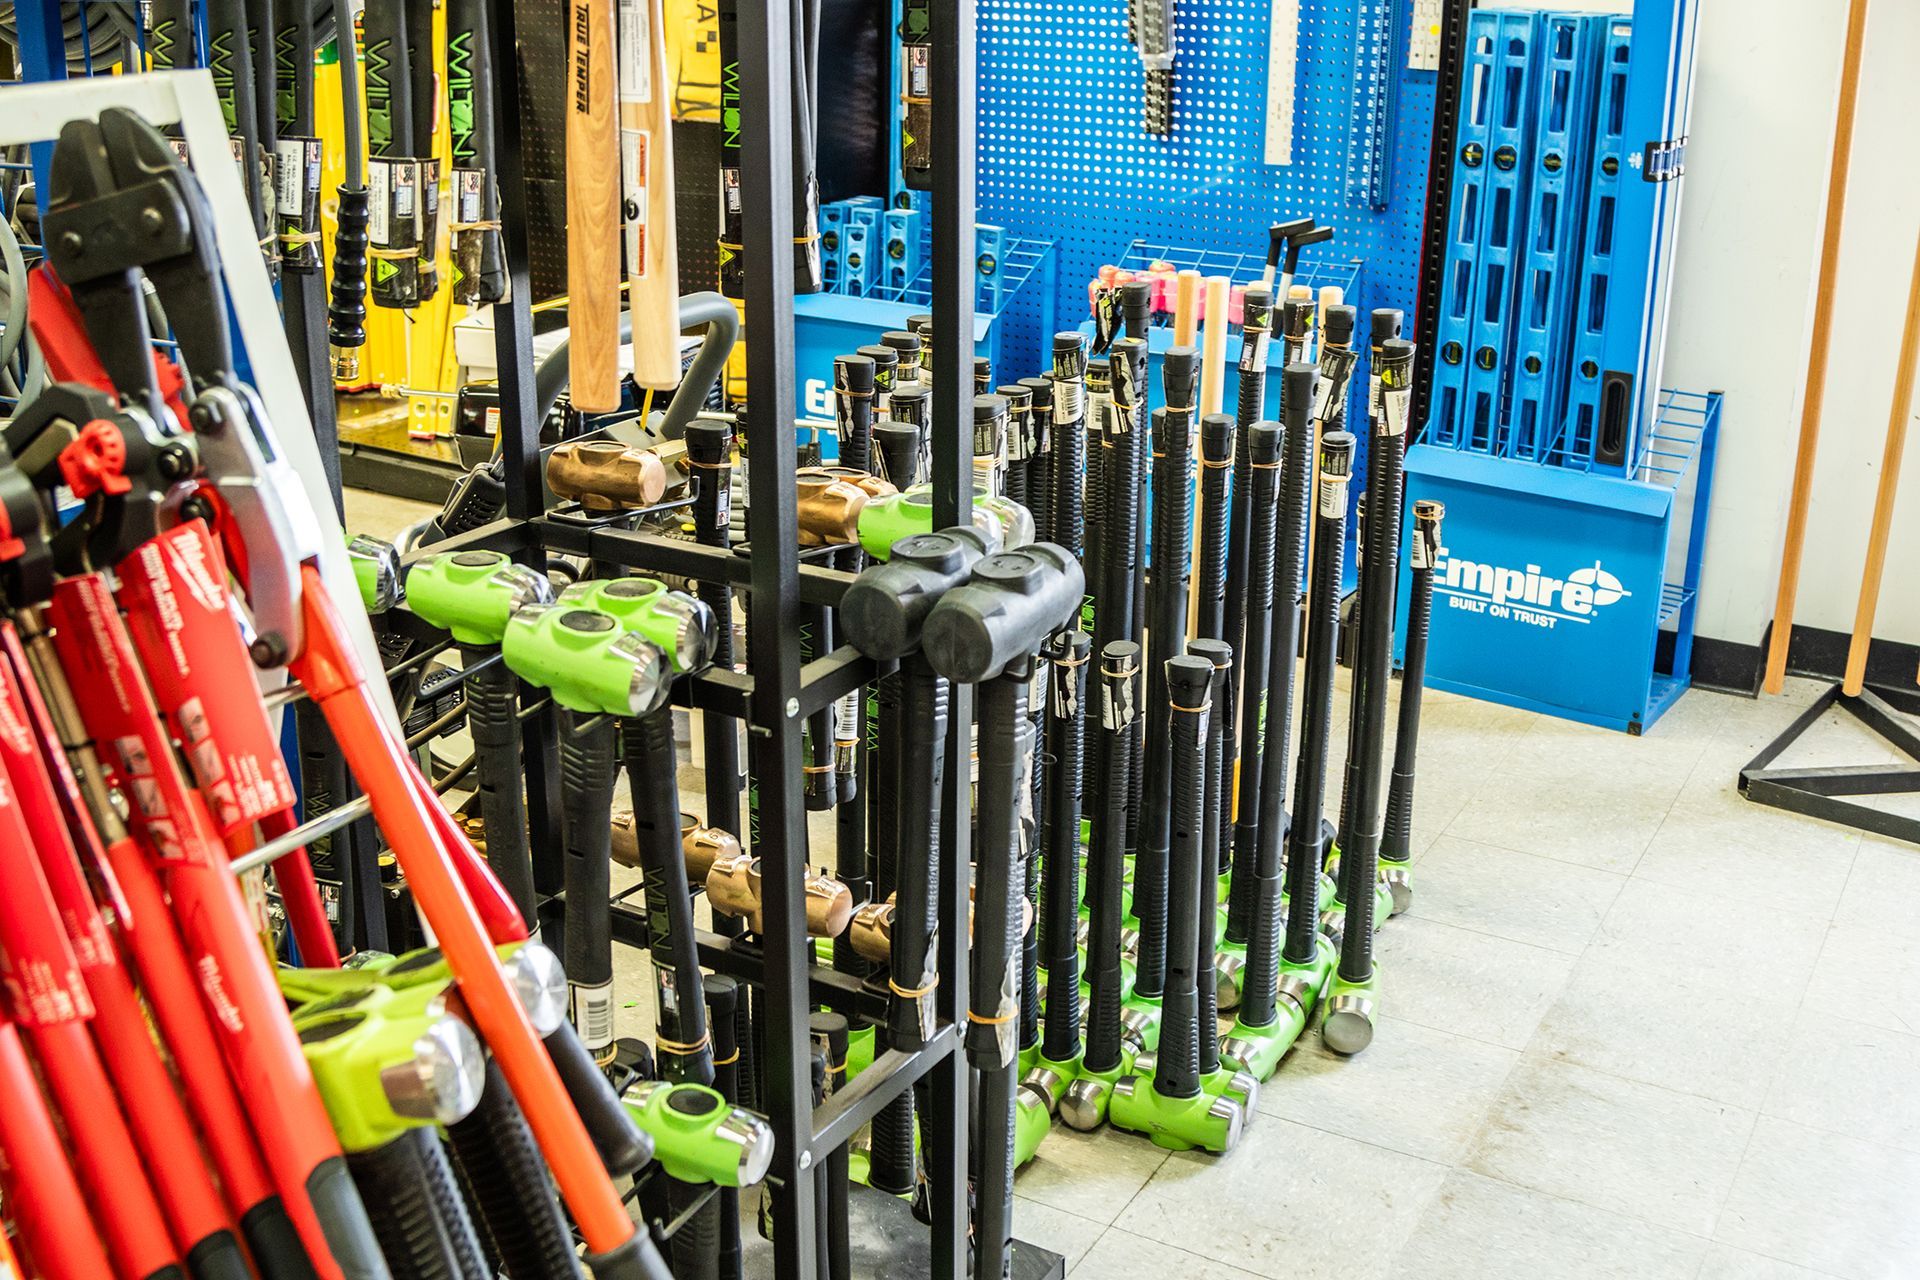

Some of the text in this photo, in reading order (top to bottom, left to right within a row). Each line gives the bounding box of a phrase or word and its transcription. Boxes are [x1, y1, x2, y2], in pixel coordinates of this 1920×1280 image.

[576, 3, 590, 113] TRUE TEMPER
[1432, 546, 1594, 615] Empire
[1449, 596, 1558, 629] BUILT ON TRUST
